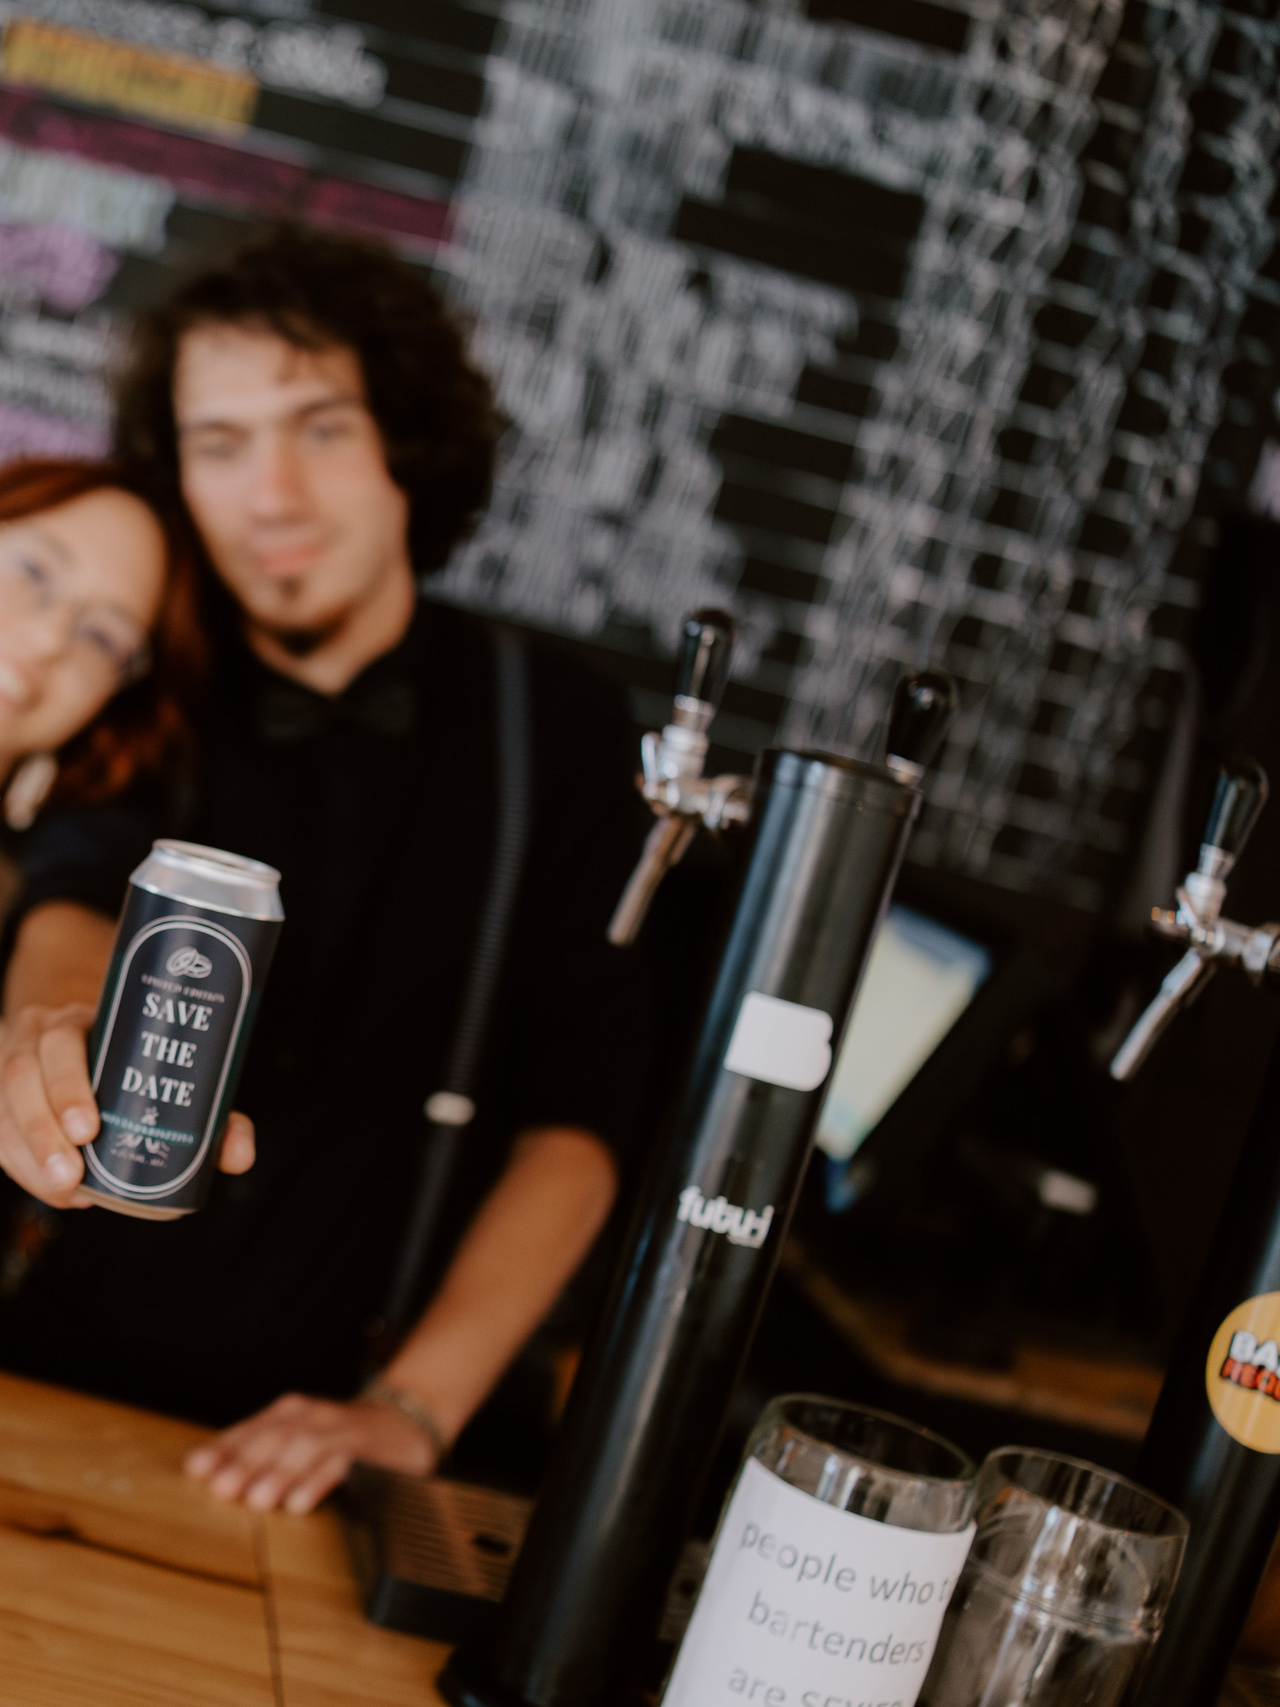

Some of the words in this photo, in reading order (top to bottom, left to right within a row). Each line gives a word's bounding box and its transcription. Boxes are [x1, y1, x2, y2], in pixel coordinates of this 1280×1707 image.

[142, 991, 213, 1031] SAVE
[140, 1030, 197, 1068] THE
[121, 1066, 195, 1107] DATE
[740, 1521, 857, 1593] people
[869, 1570, 934, 1605] who
[747, 1589, 928, 1666] bartenders
[727, 1666, 787, 1707] are
